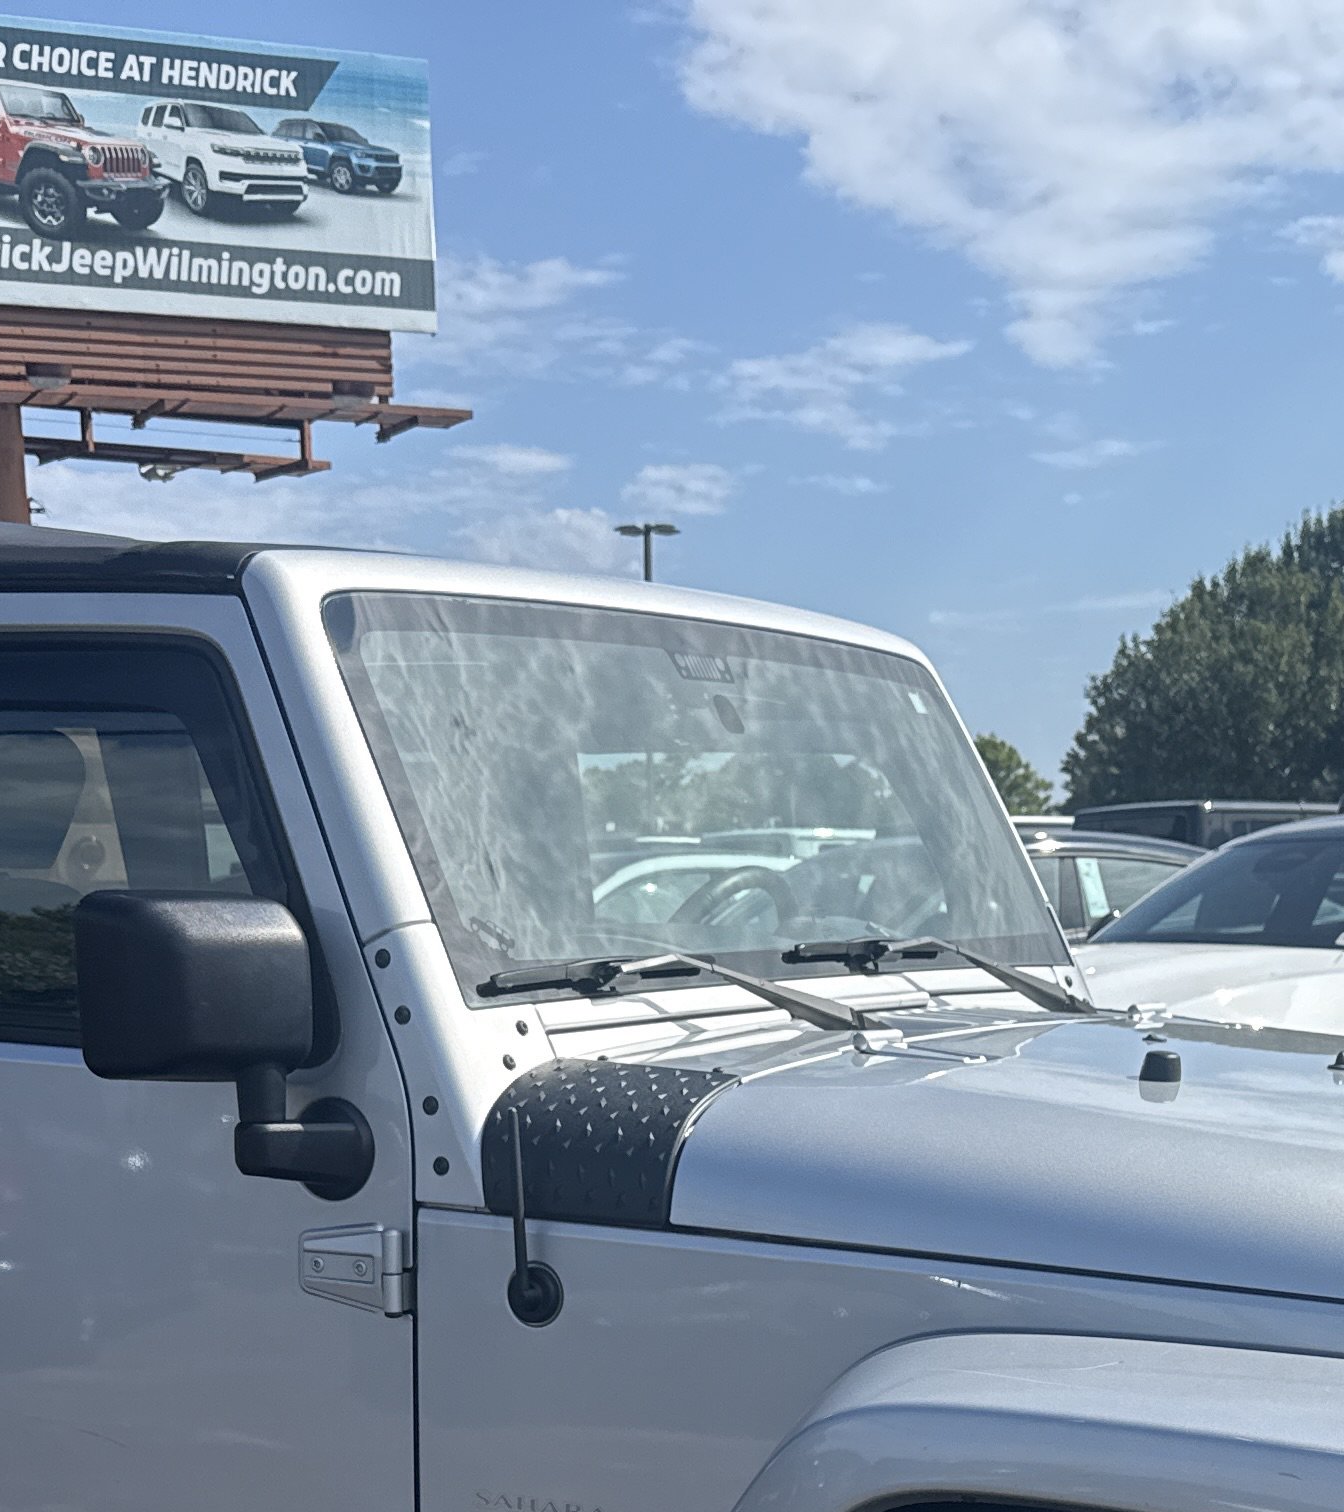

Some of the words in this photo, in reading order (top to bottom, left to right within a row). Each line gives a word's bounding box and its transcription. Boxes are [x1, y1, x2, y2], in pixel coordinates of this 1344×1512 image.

[12, 43, 115, 79] CHOICE
[120, 53, 156, 83] AT
[161, 57, 298, 98] HENDRICK
